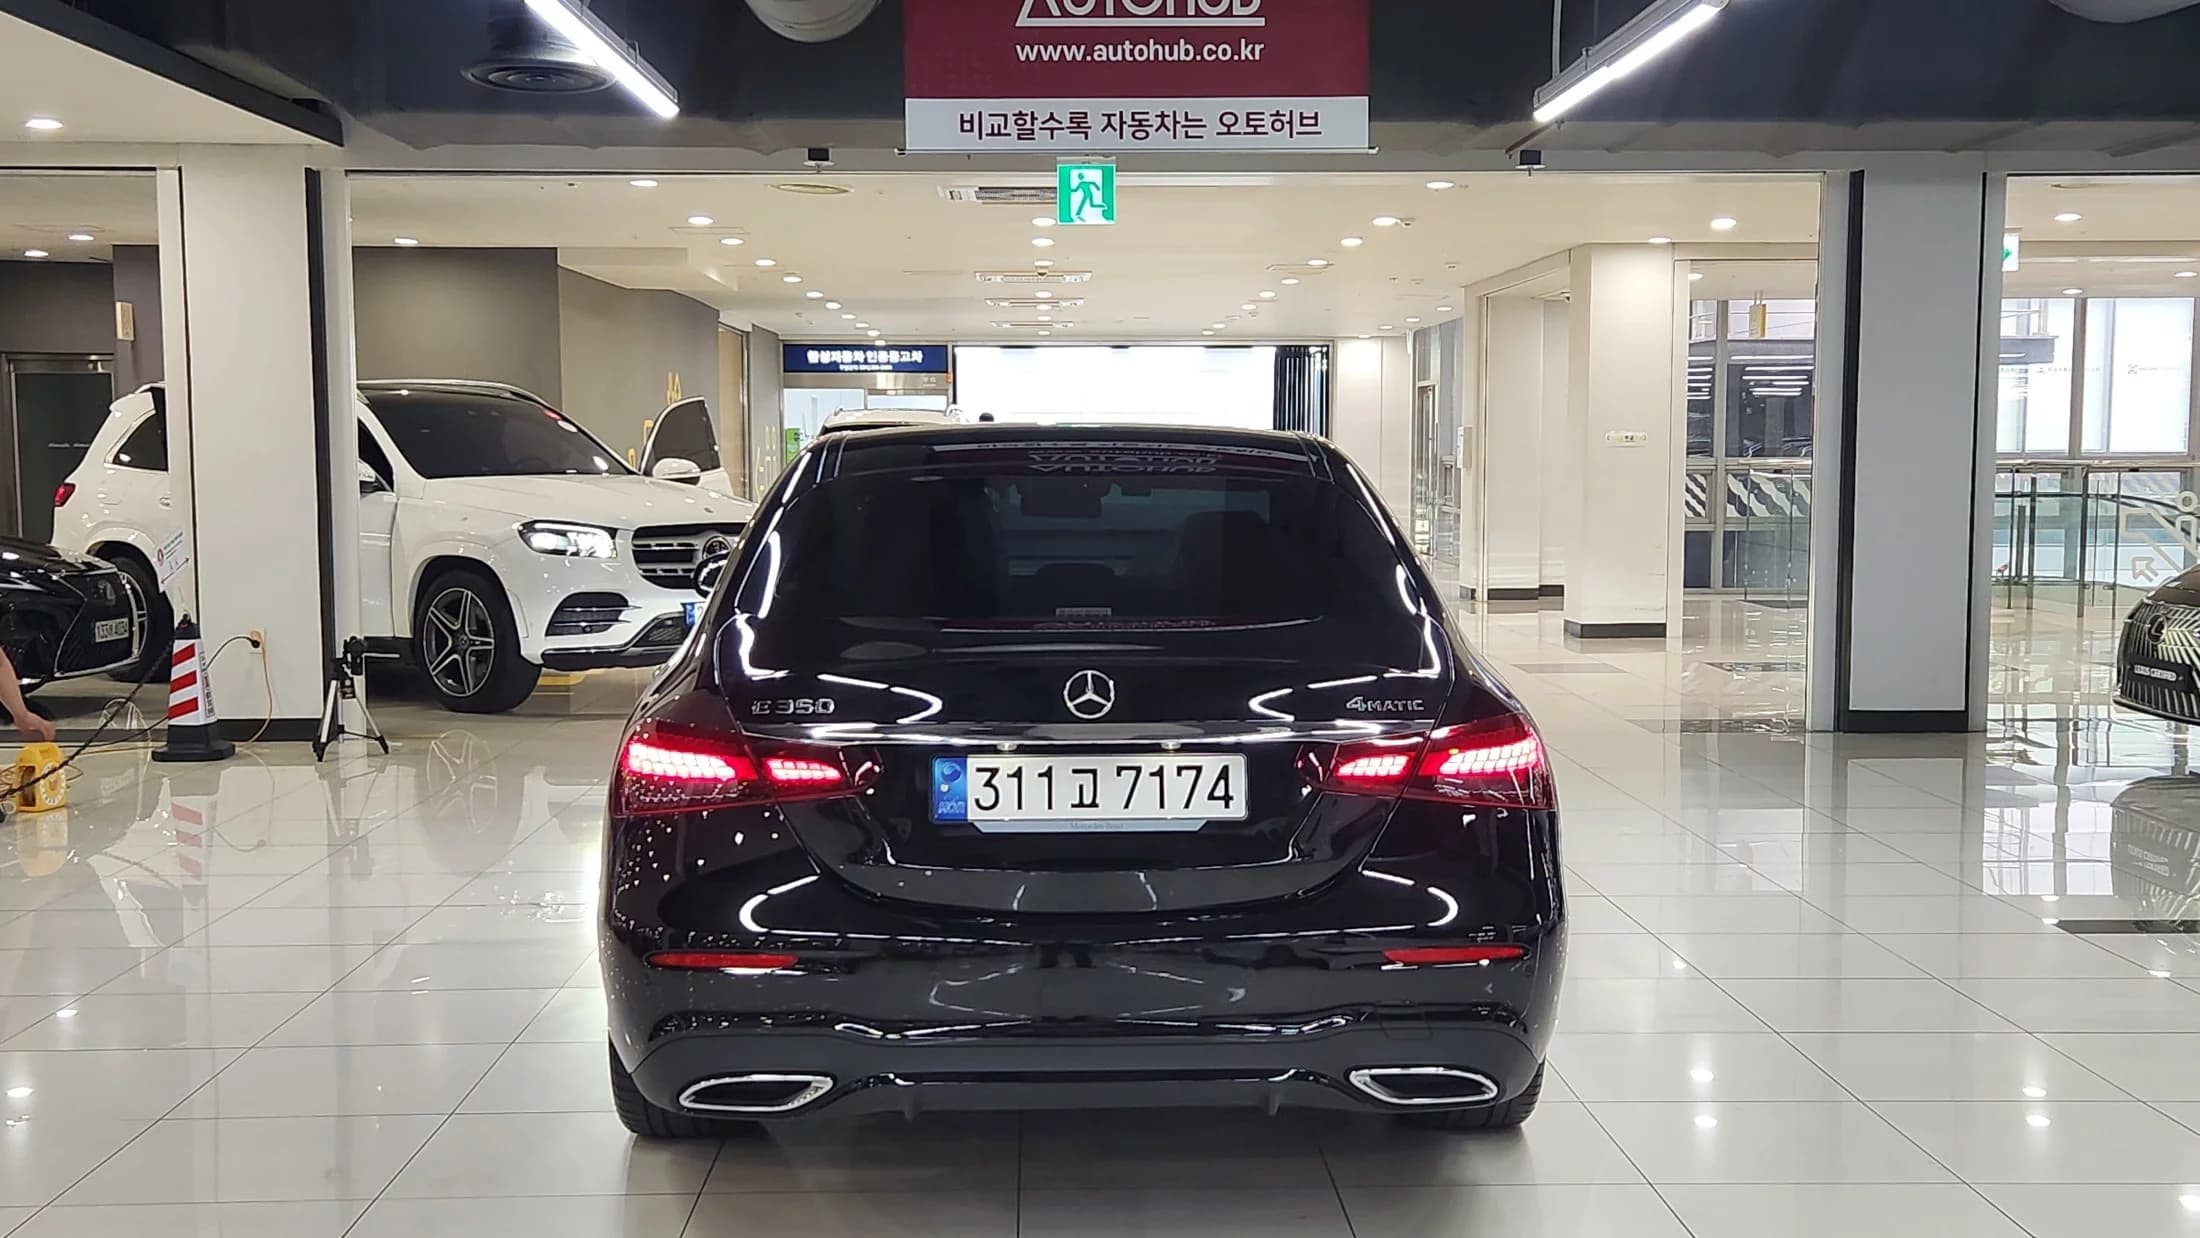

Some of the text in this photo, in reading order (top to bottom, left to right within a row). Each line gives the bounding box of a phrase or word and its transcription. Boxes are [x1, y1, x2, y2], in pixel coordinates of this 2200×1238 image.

[1015, 38, 1265, 62] www.autohub.co.kr
[959, 110, 1322, 141] 비교할수록 자동차는 오토허브
[1345, 696, 1425, 712] 4MATIC
[973, 764, 1234, 812] 311고 7174
